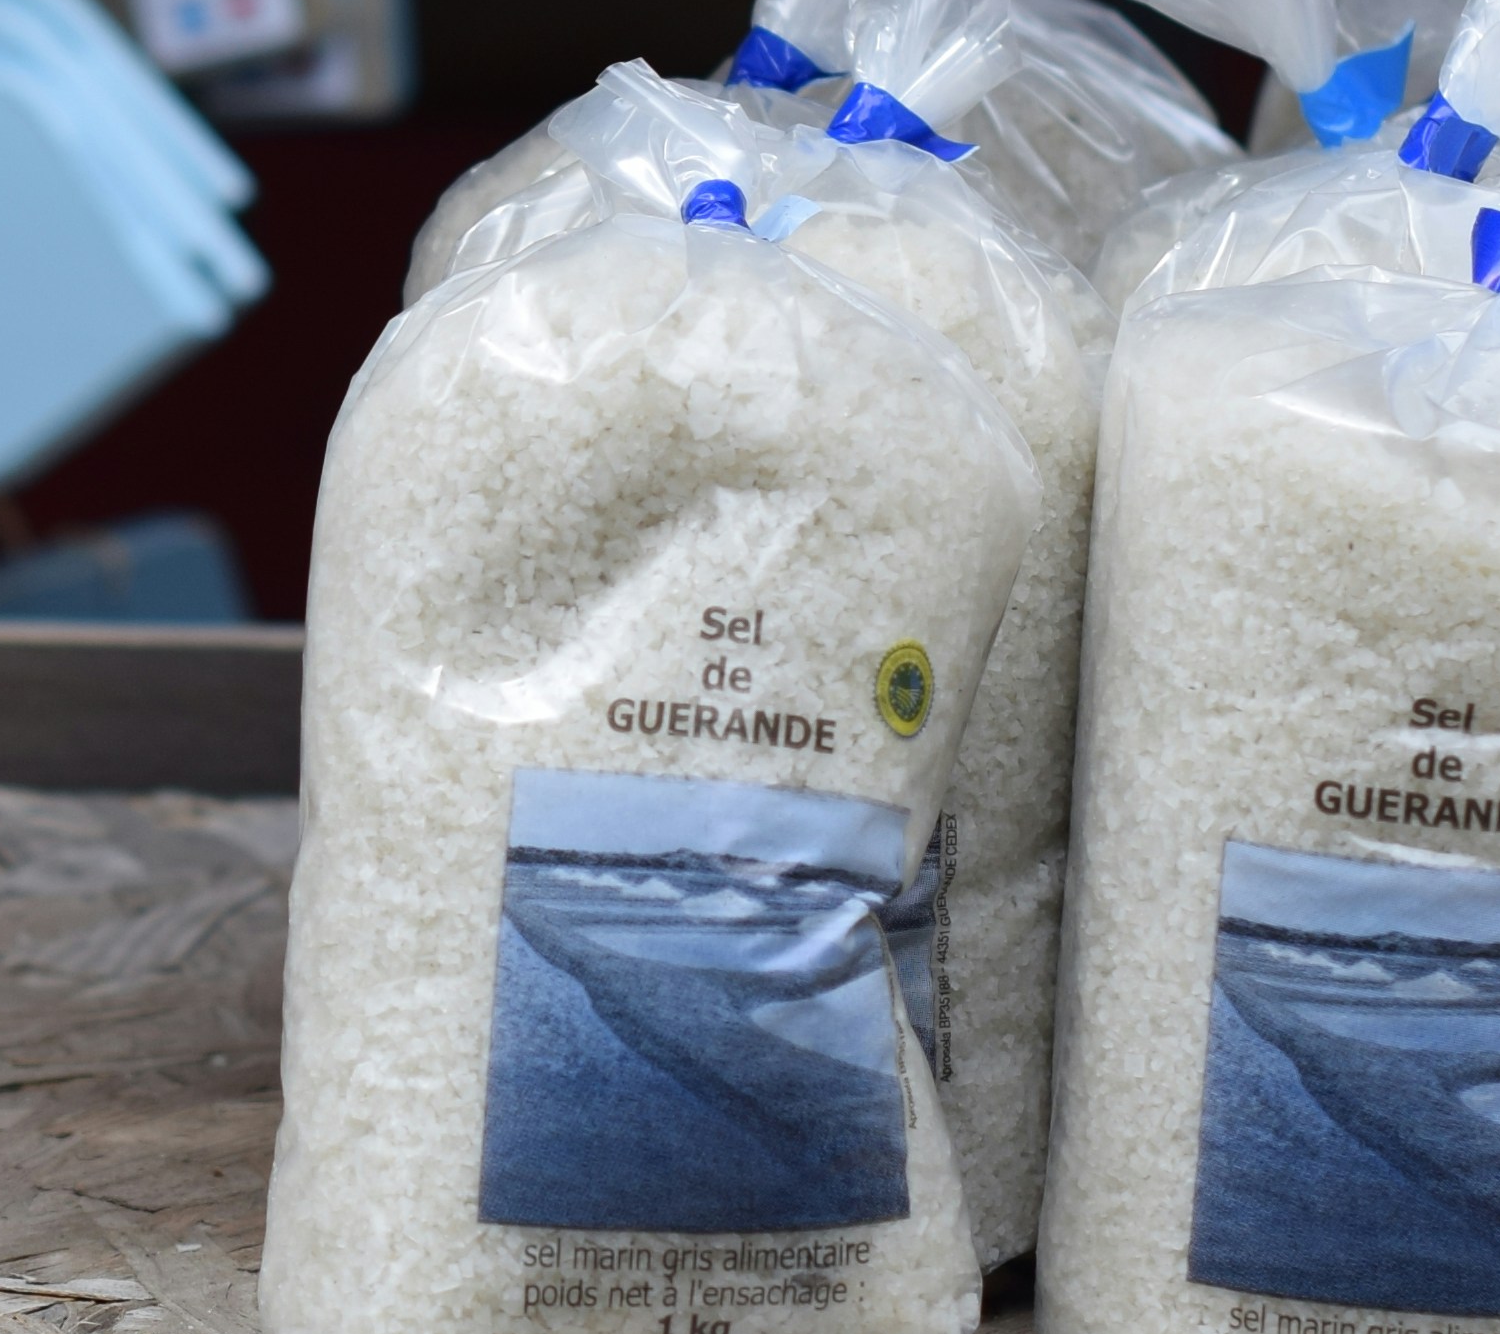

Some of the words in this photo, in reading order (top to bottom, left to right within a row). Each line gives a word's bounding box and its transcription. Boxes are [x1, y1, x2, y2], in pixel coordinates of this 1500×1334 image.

[700, 606, 765, 647] Sel
[701, 657, 752, 696] de
[607, 698, 837, 753] GUERANDE
[1409, 698, 1475, 733] Sel
[1411, 745, 1464, 782] de
[941, 813, 958, 856] CEDEX
[937, 975, 951, 1029] BP35188
[524, 1238, 561, 1268] sel
[574, 1242, 651, 1269] marin
[663, 1243, 712, 1278] gris
[724, 1238, 870, 1270] alimentaire
[524, 1278, 596, 1312] poids
[609, 1282, 652, 1307] net
[663, 1276, 677, 1307] à
[690, 1278, 847, 1310] l'ensachage
[1229, 1305, 1265, 1333] sel
